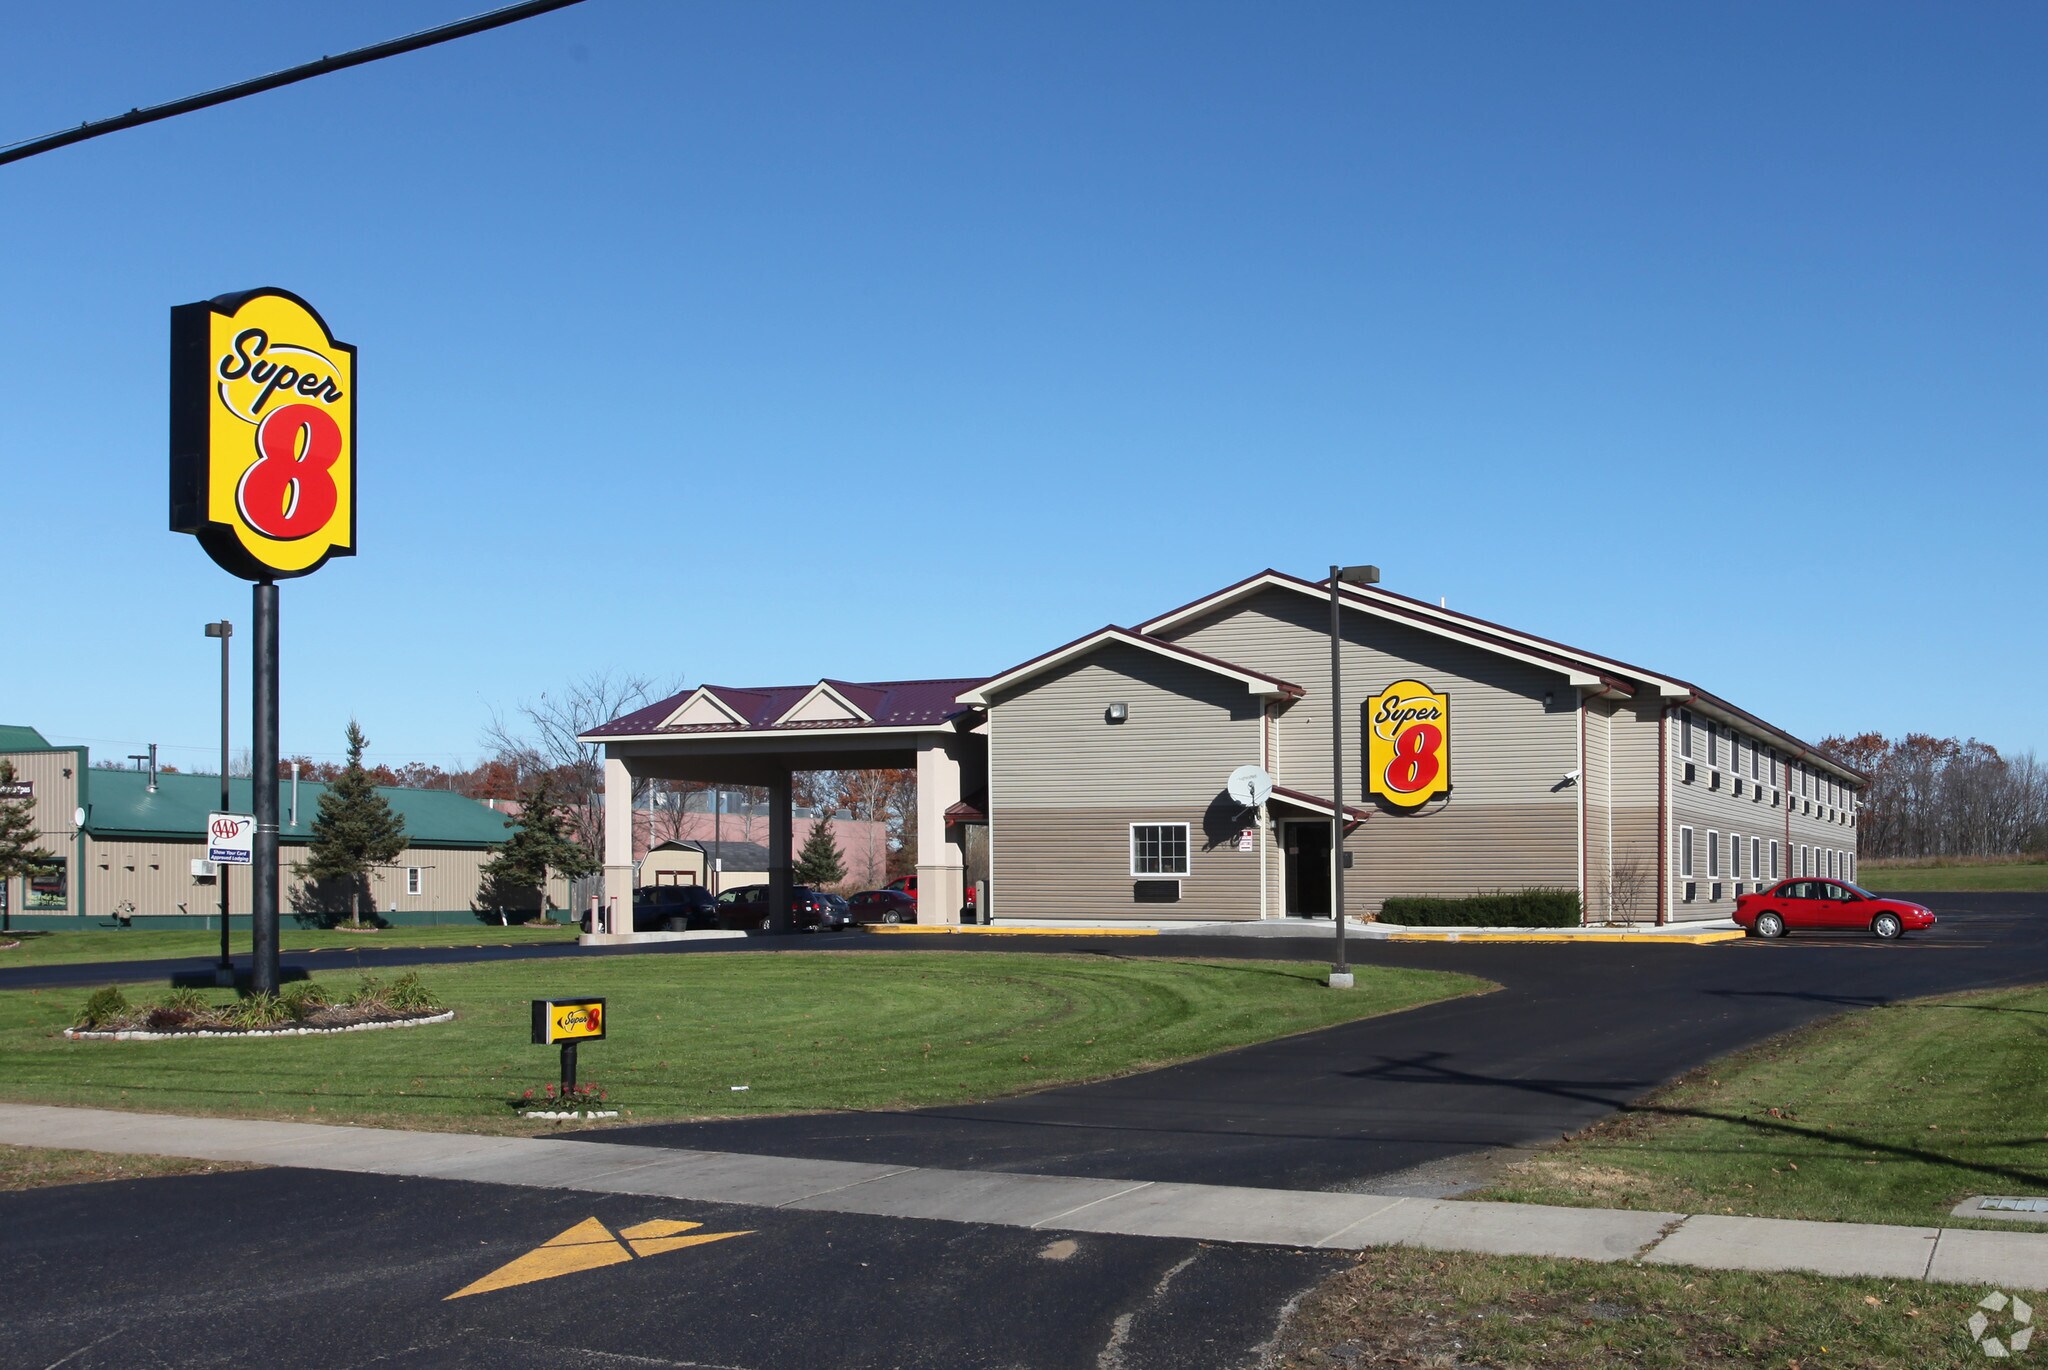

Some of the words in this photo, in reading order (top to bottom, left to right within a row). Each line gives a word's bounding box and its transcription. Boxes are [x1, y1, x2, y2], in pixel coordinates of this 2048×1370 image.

[218, 328, 343, 415] Super
[234, 404, 342, 541] 8
[1374, 695, 1442, 736] Super
[1384, 723, 1442, 793] 8
[214, 819, 237, 838] AAA
[565, 1011, 588, 1031] Super
[586, 1008, 600, 1032] 8
